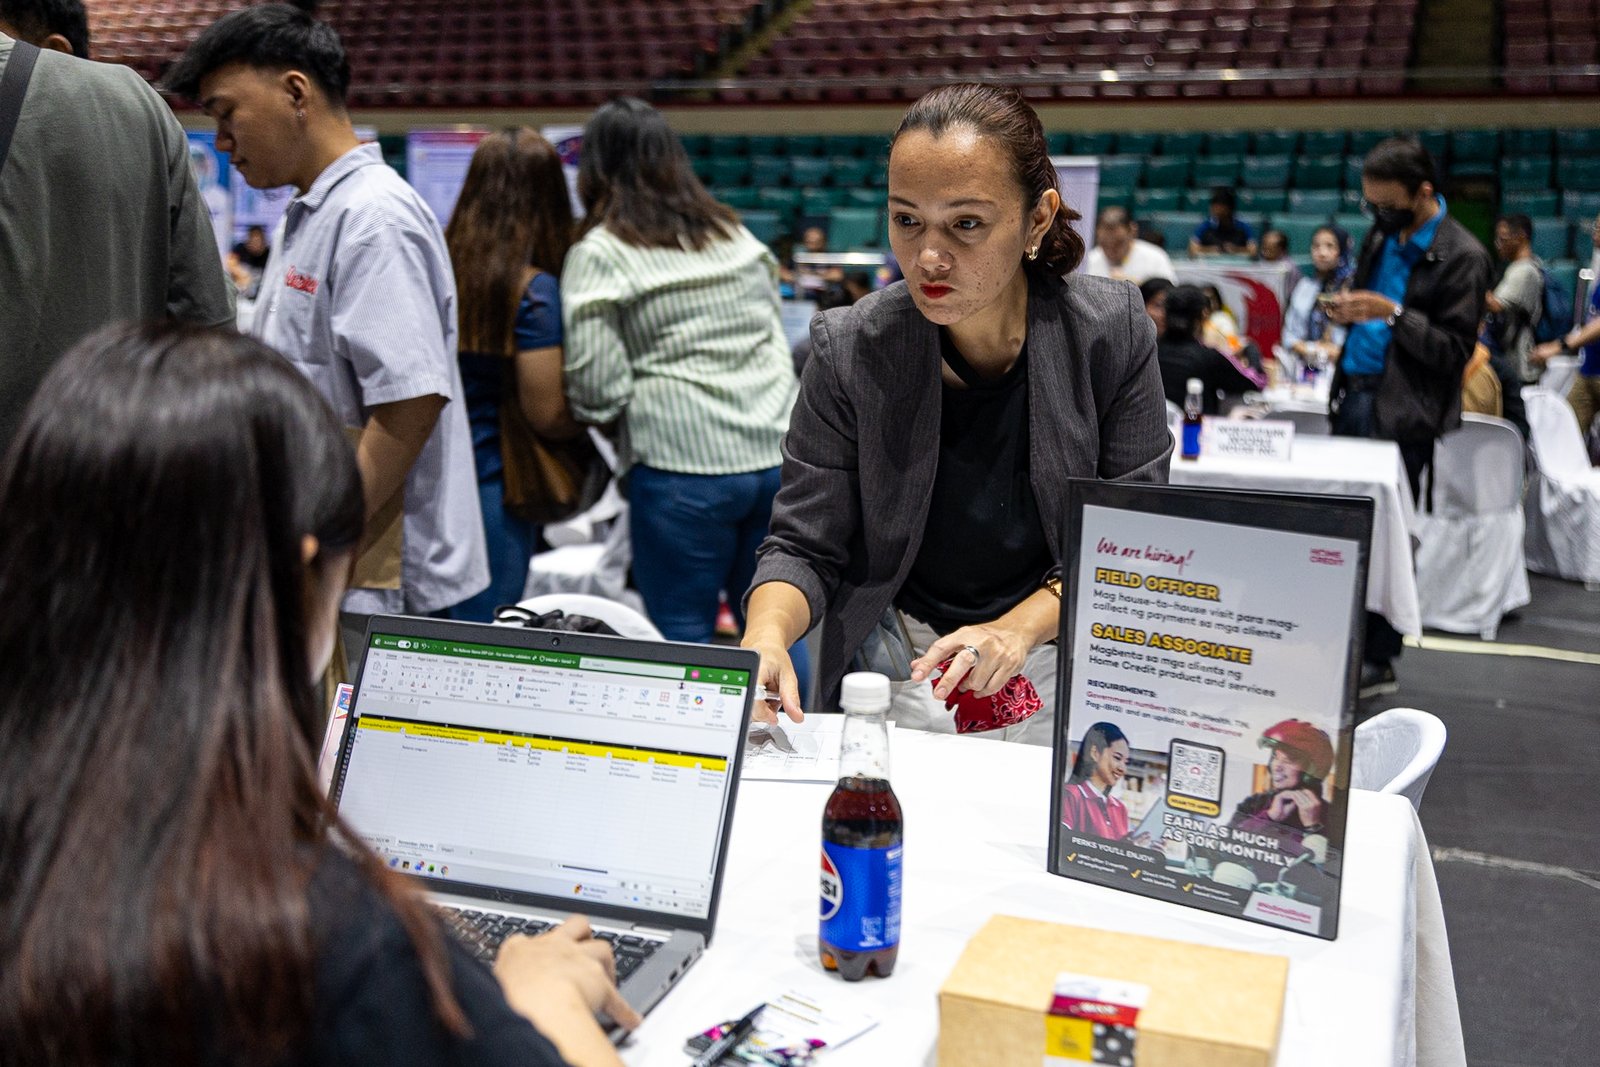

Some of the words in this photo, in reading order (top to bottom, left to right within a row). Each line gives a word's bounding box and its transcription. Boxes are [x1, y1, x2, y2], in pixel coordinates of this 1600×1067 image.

[1097, 537, 1117, 556] We
[1121, 547, 1141, 559] are
[1144, 545, 1195, 575] hiring!
[1095, 567, 1142, 589] FIELD
[1144, 575, 1221, 602] OFFICER
[1092, 601, 1129, 615] collect
[1130, 608, 1144, 619] ng
[1146, 611, 1196, 626] payment
[1200, 619, 1212, 628] sa
[1214, 622, 1240, 634] mga
[1242, 626, 1282, 639] clients
[1093, 588, 1116, 602] Mag
[1118, 591, 1207, 614] house-to-house
[1209, 607, 1234, 620] visit
[1236, 613, 1264, 623] para
[1266, 618, 1299, 632] mag-
[1089, 643, 1143, 660] Magbenta
[1146, 655, 1159, 663] sa
[1161, 657, 1185, 669] mga
[1187, 661, 1225, 675] clients
[1227, 669, 1242, 681] ng
[1091, 622, 1146, 646] SALES
[1147, 632, 1253, 665] ASSOCIATE
[1087, 679, 1158, 698] REQUIREMENTS:
[1088, 655, 1119, 668] Home
[1121, 660, 1157, 675] Credit
[1159, 669, 1202, 683] product
[1204, 677, 1225, 688] and
[1228, 682, 1276, 697] services
[1071, 836, 1098, 849] PERKS
[1098, 843, 1126, 857] YOU'LL
[1162, 826, 1183, 842] AS
[1186, 832, 1217, 850] 30K
[1219, 840, 1297, 868] MONTHLY
[1163, 812, 1205, 832] EARN
[1207, 822, 1230, 838] AS
[1231, 829, 1280, 850] MUCH
